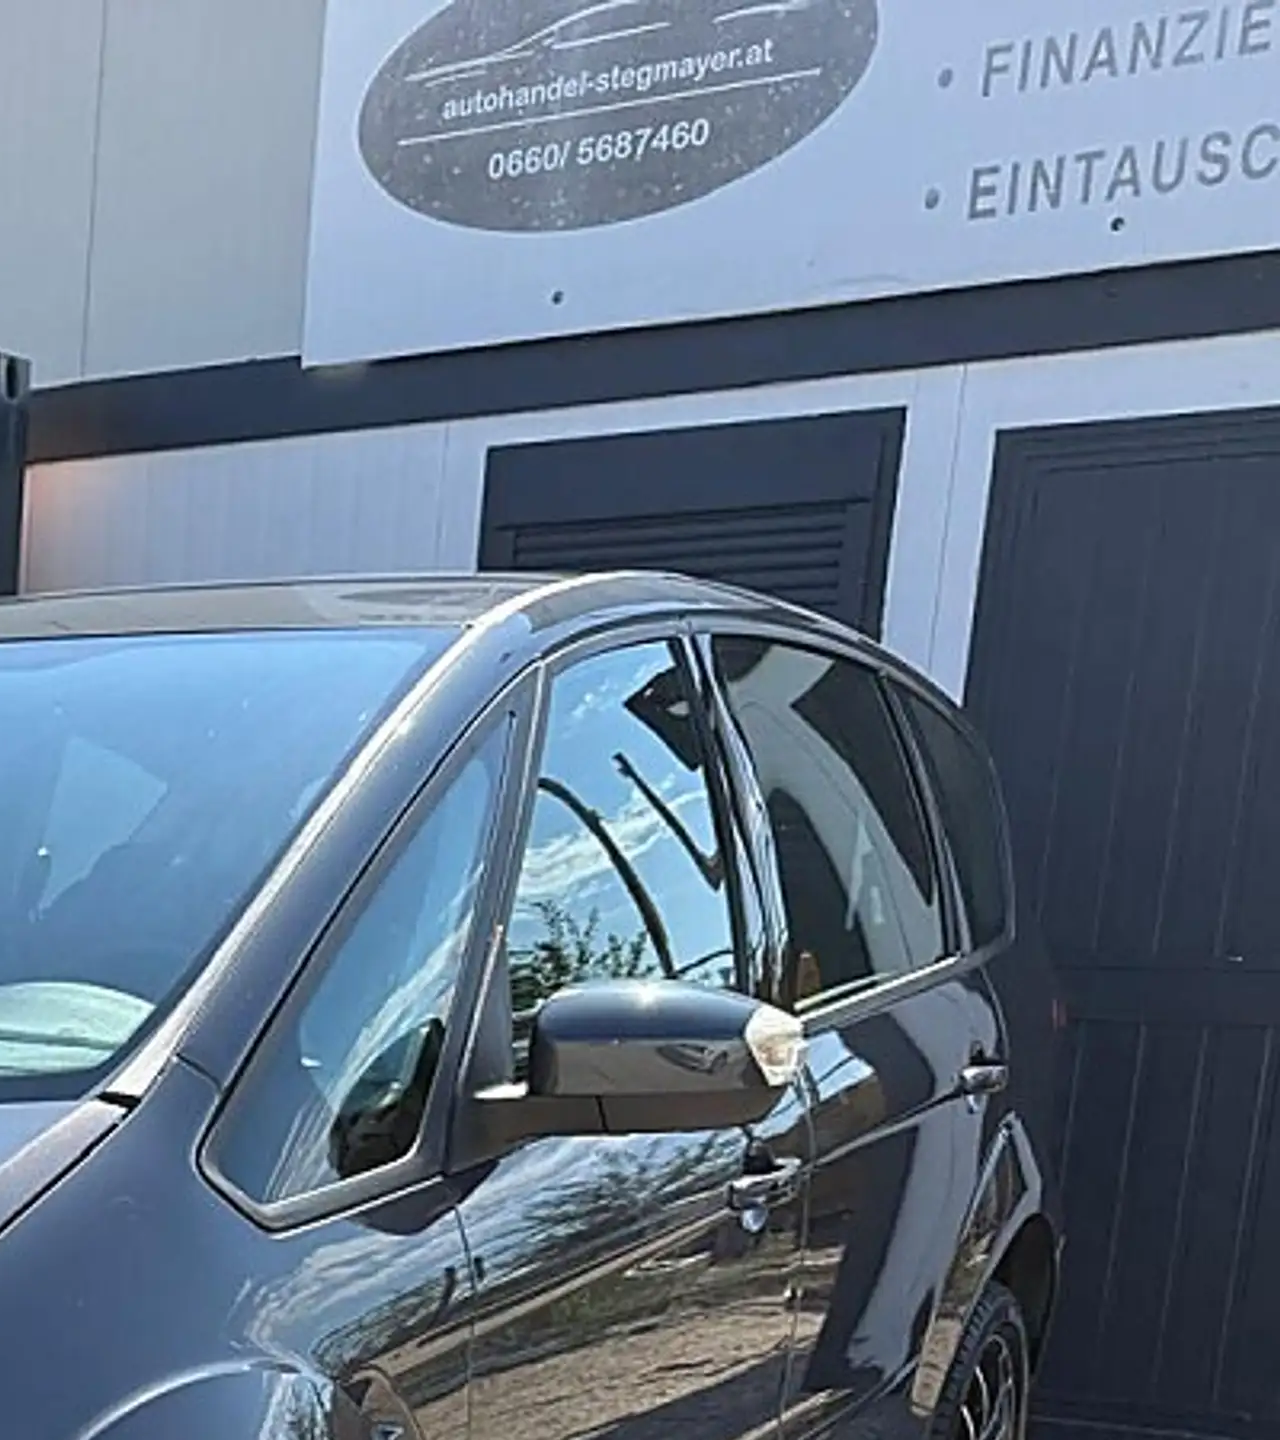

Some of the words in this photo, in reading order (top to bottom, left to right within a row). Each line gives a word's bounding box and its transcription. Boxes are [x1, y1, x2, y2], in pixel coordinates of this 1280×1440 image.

[442, 38, 774, 120] autohandel-stegmayer.at
[488, 140, 569, 181] 0660/
[575, 117, 710, 167] 5687460
[966, 123, 1280, 221] EINTAUSC
